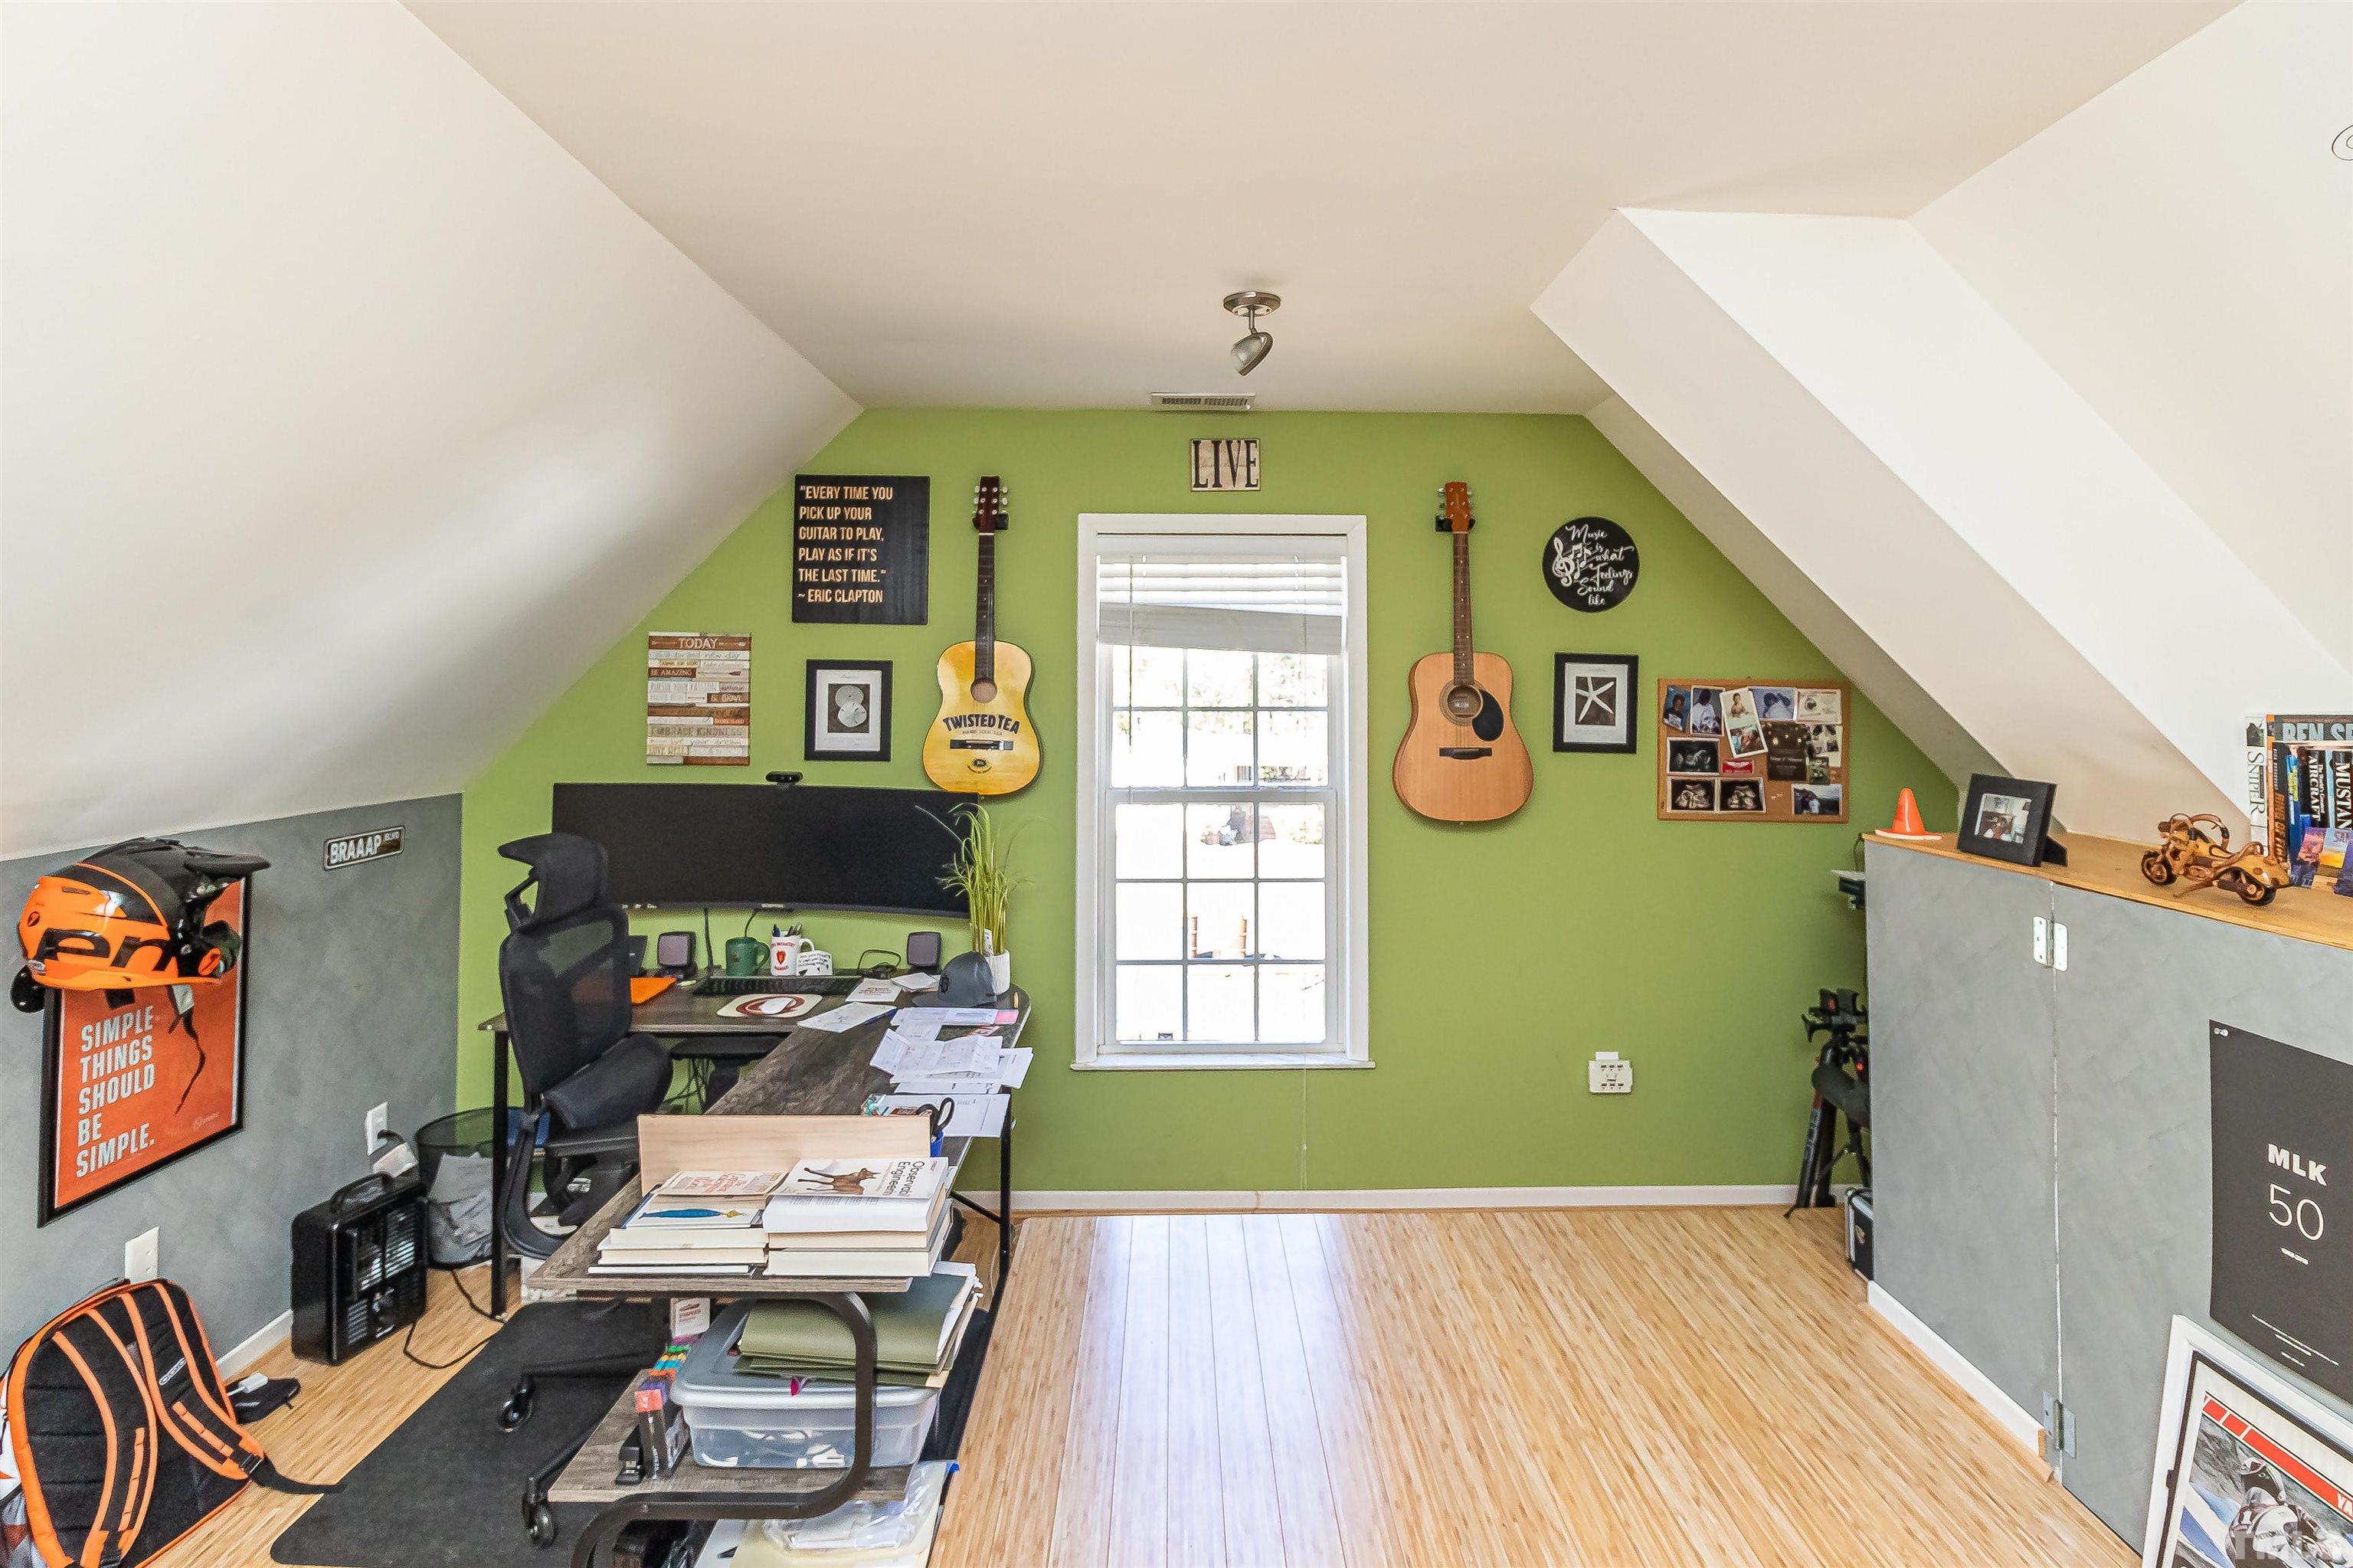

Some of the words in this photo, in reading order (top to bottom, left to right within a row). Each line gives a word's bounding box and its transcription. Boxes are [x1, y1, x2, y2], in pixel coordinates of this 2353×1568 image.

[1193, 440, 1258, 488] LIVE
[800, 485, 840, 499] "EVERY
[843, 486, 869, 499] TIME
[872, 486, 893, 500] YOU
[800, 506, 824, 519] PICK
[827, 506, 841, 519] UP
[844, 506, 872, 520] YOUR
[799, 526, 837, 540] GUITAR
[839, 527, 853, 540] TO
[856, 527, 884, 542] PLAY,
[1565, 524, 1608, 543] Music
[799, 548, 825, 561] PLAY
[827, 548, 842, 561] AS
[844, 548, 855, 561] IF
[857, 548, 877, 561] IT'S
[798, 568, 819, 582] THE
[822, 568, 849, 582] LAST
[807, 588, 832, 603] ERIC
[835, 589, 883, 603] CLAPTON
[679, 637, 719, 649] TODAY
[942, 713, 996, 732] TWISTED
[998, 714, 1020, 735] TEA
[2247, 751, 2266, 815] SNIPER
[2308, 755, 2321, 822] AIRCRAFT
[330, 834, 382, 864] BRAAAP
[80, 1005, 154, 1052] SIMPLE
[80, 1034, 153, 1083] THINGS
[79, 1063, 155, 1115] SHOULD
[77, 1112, 102, 1147] BE
[76, 1122, 155, 1178] SIMPLE.
[2268, 1143, 2328, 1187] MLK
[2269, 1183, 2324, 1241] 50
